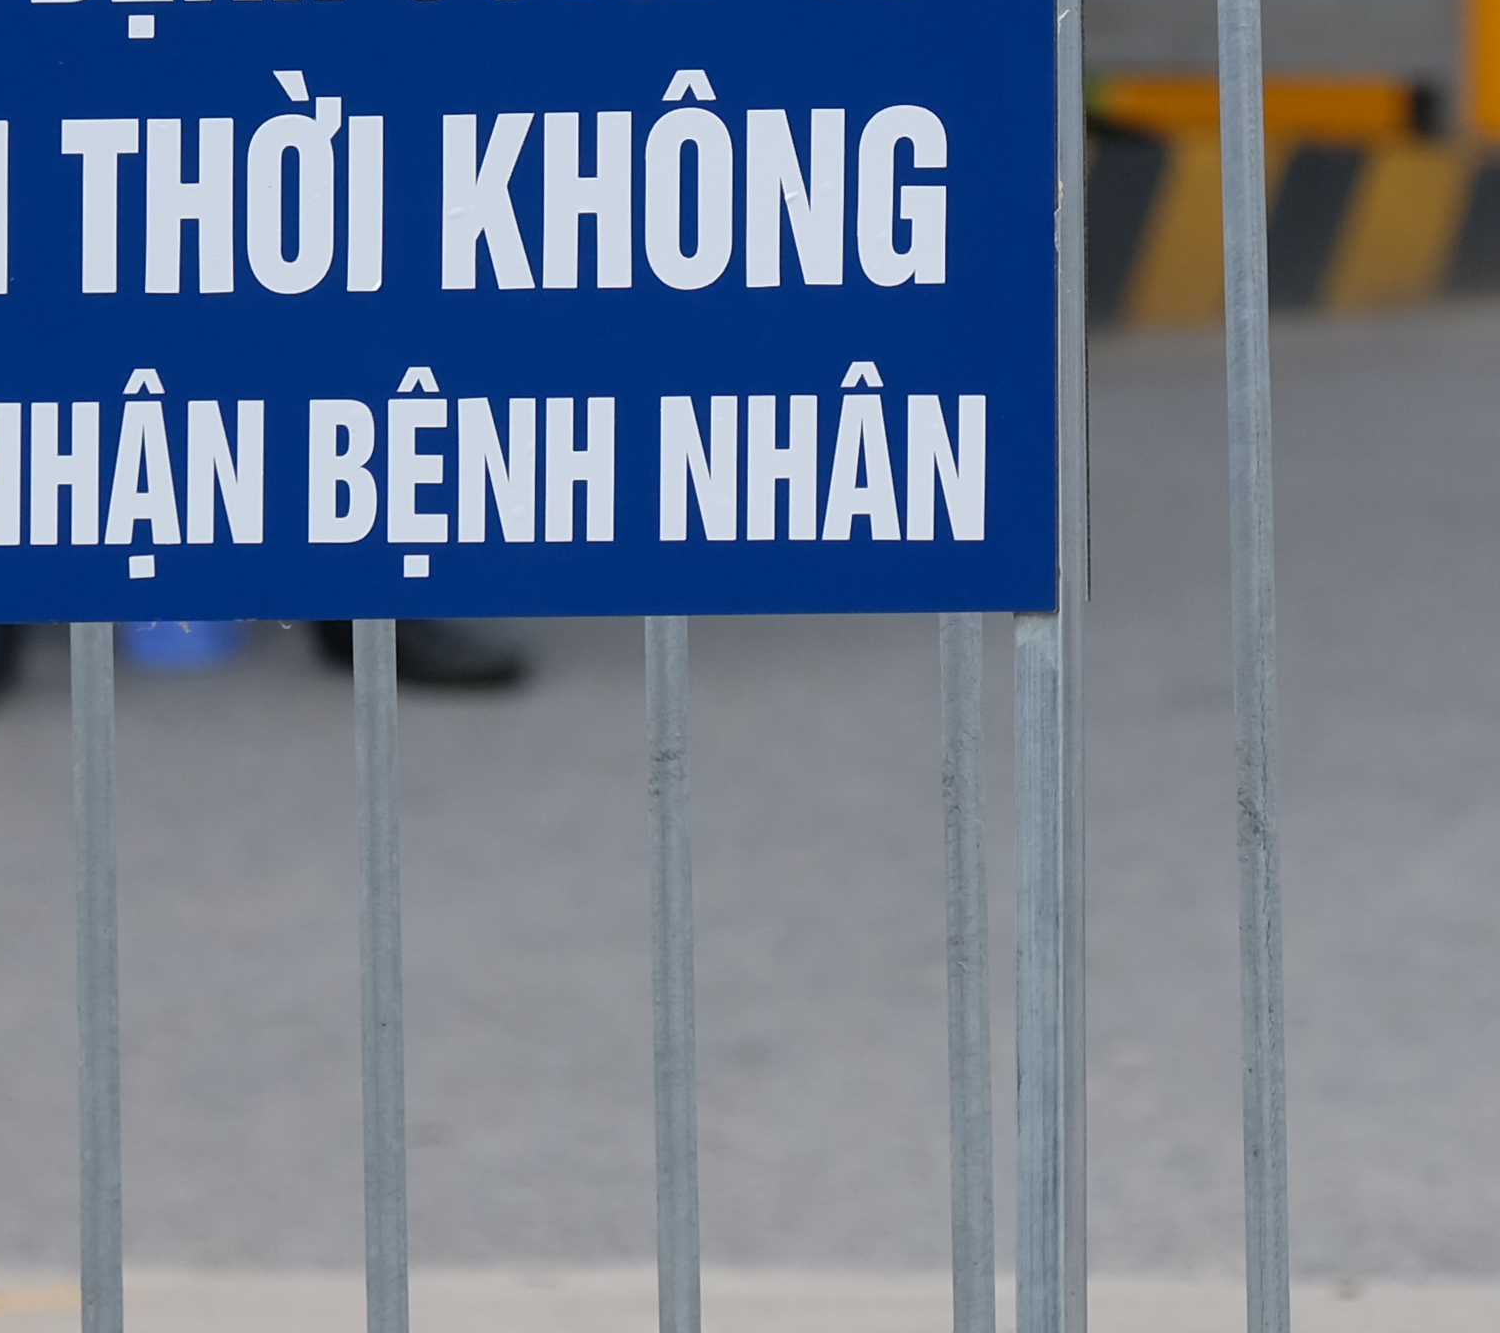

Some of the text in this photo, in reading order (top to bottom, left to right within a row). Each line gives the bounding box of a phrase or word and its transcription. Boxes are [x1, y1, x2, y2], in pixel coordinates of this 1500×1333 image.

[61, 70, 384, 295] THỜI
[441, 69, 948, 291] KHÔNG
[308, 366, 616, 578] BỆNH
[659, 361, 987, 542] NHÂN
